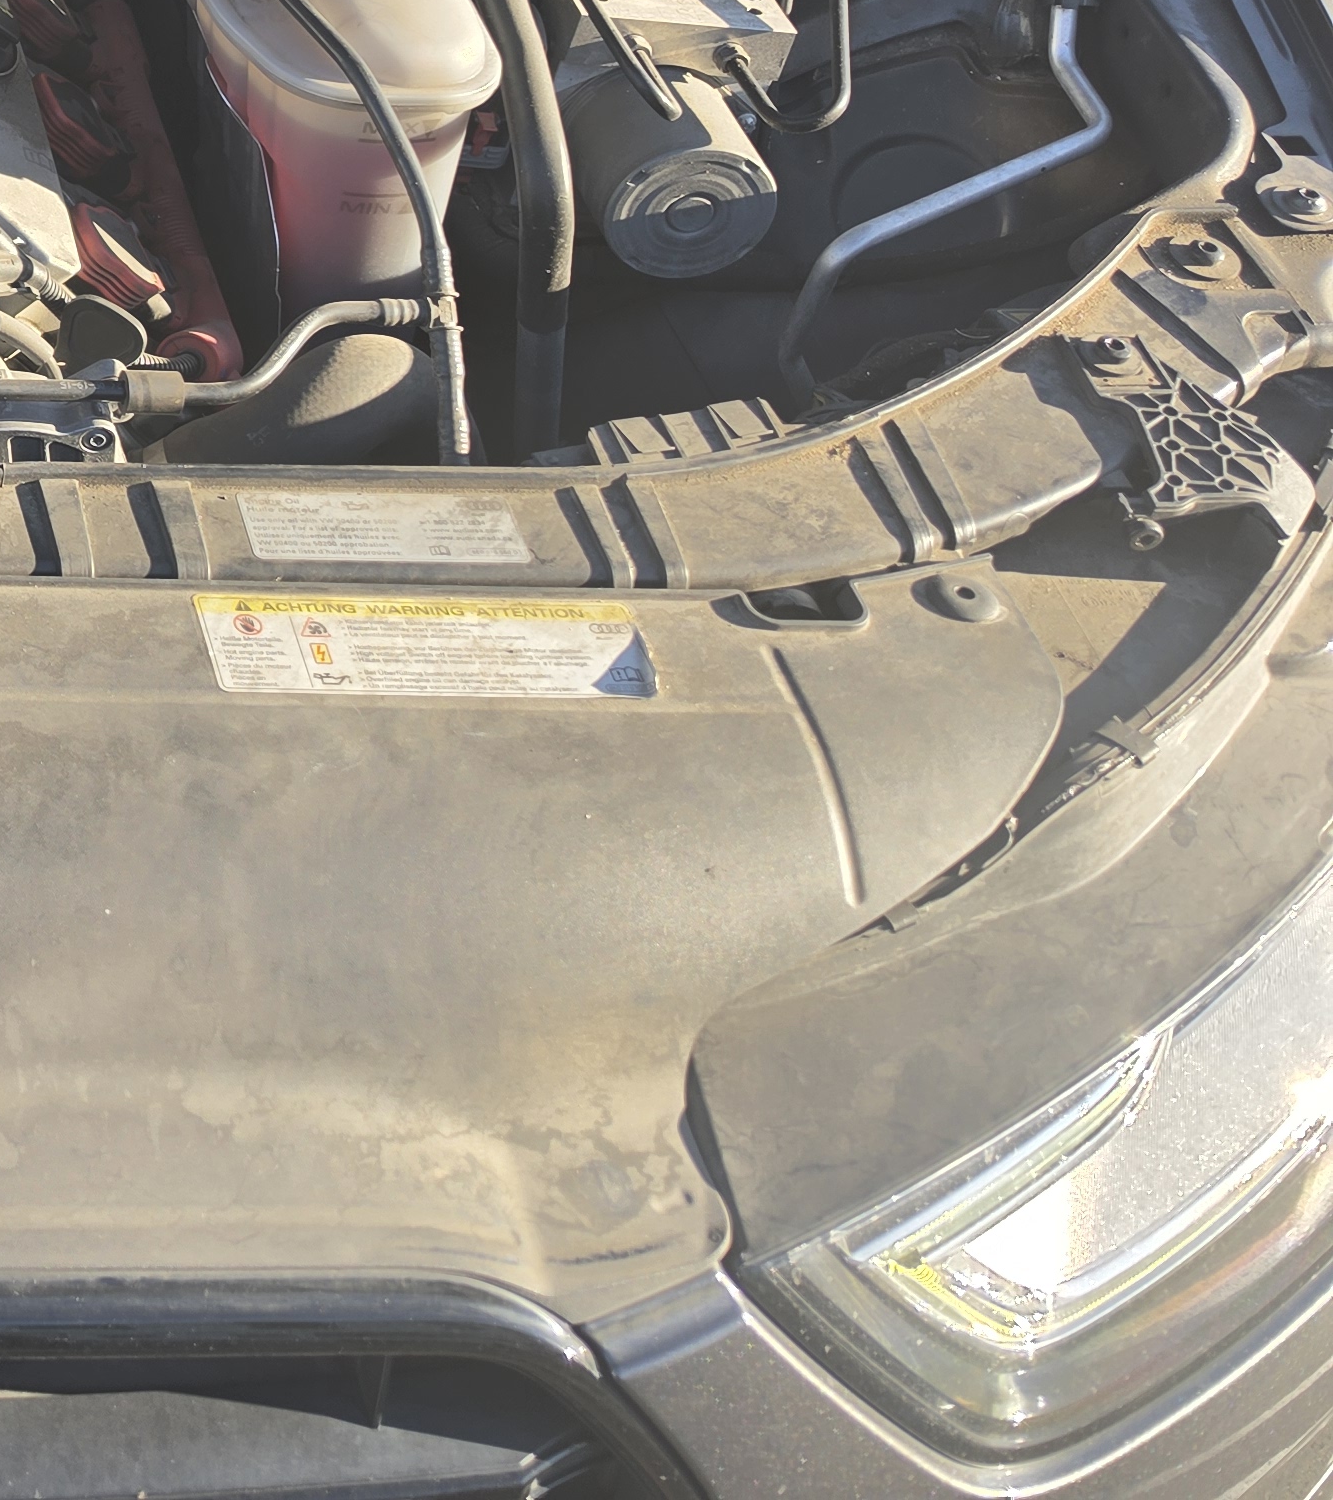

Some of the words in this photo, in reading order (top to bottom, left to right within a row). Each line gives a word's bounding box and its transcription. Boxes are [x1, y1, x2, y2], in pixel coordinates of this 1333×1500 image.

[362, 121, 420, 134] MX
[340, 201, 391, 215] MIN
[262, 601, 357, 615] ACHTUNG
[366, 603, 465, 618] WARNING
[477, 605, 585, 620] ATTENTION
